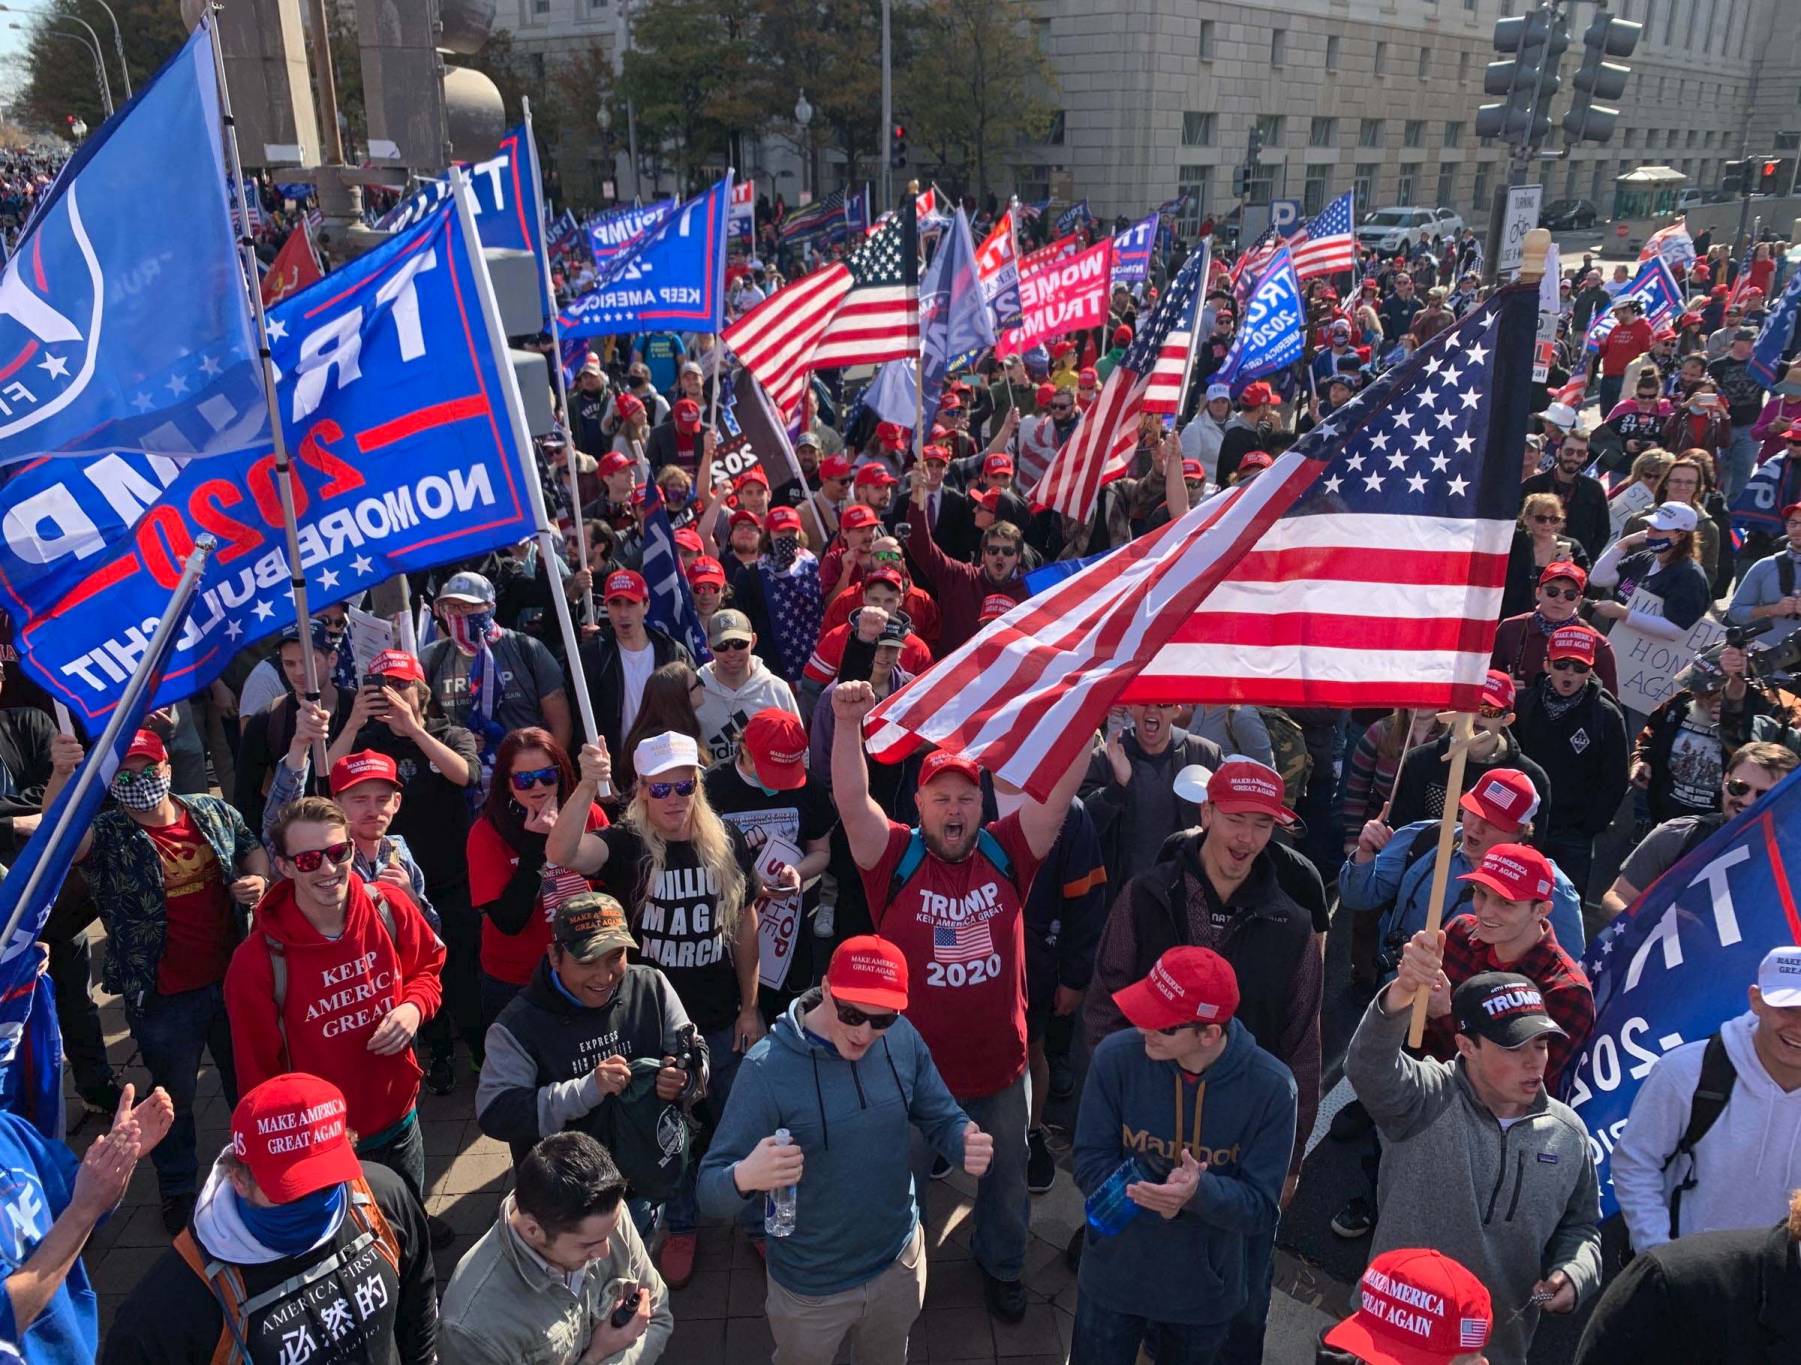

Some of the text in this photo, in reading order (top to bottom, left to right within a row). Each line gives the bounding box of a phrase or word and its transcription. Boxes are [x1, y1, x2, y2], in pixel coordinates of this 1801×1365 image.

[443, 671, 513, 693] TRP
[653, 867, 719, 901] MILLIO
[919, 882, 999, 922] TRUMP
[978, 903, 1004, 922] GREAT
[640, 936, 723, 968] MARCH
[851, 955, 899, 970] MAKE AMERICA
[321, 950, 378, 989] KEEP
[853, 963, 896, 978] GREAT AGAIN
[926, 953, 1002, 988] 2020
[303, 970, 402, 1023] AMERICA
[1482, 990, 1542, 1016] TRUMP
[321, 996, 398, 1039] GREAT
[579, 1030, 619, 1053] EXPRESS
[256, 1098, 347, 1136] MAKE AMERICA
[267, 1119, 343, 1155] GREAT AGAIN
[261, 1280, 339, 1336] AMERICA
[1385, 1277, 1445, 1317] AMERICA
[1387, 1305, 1433, 1338] AGAIN
